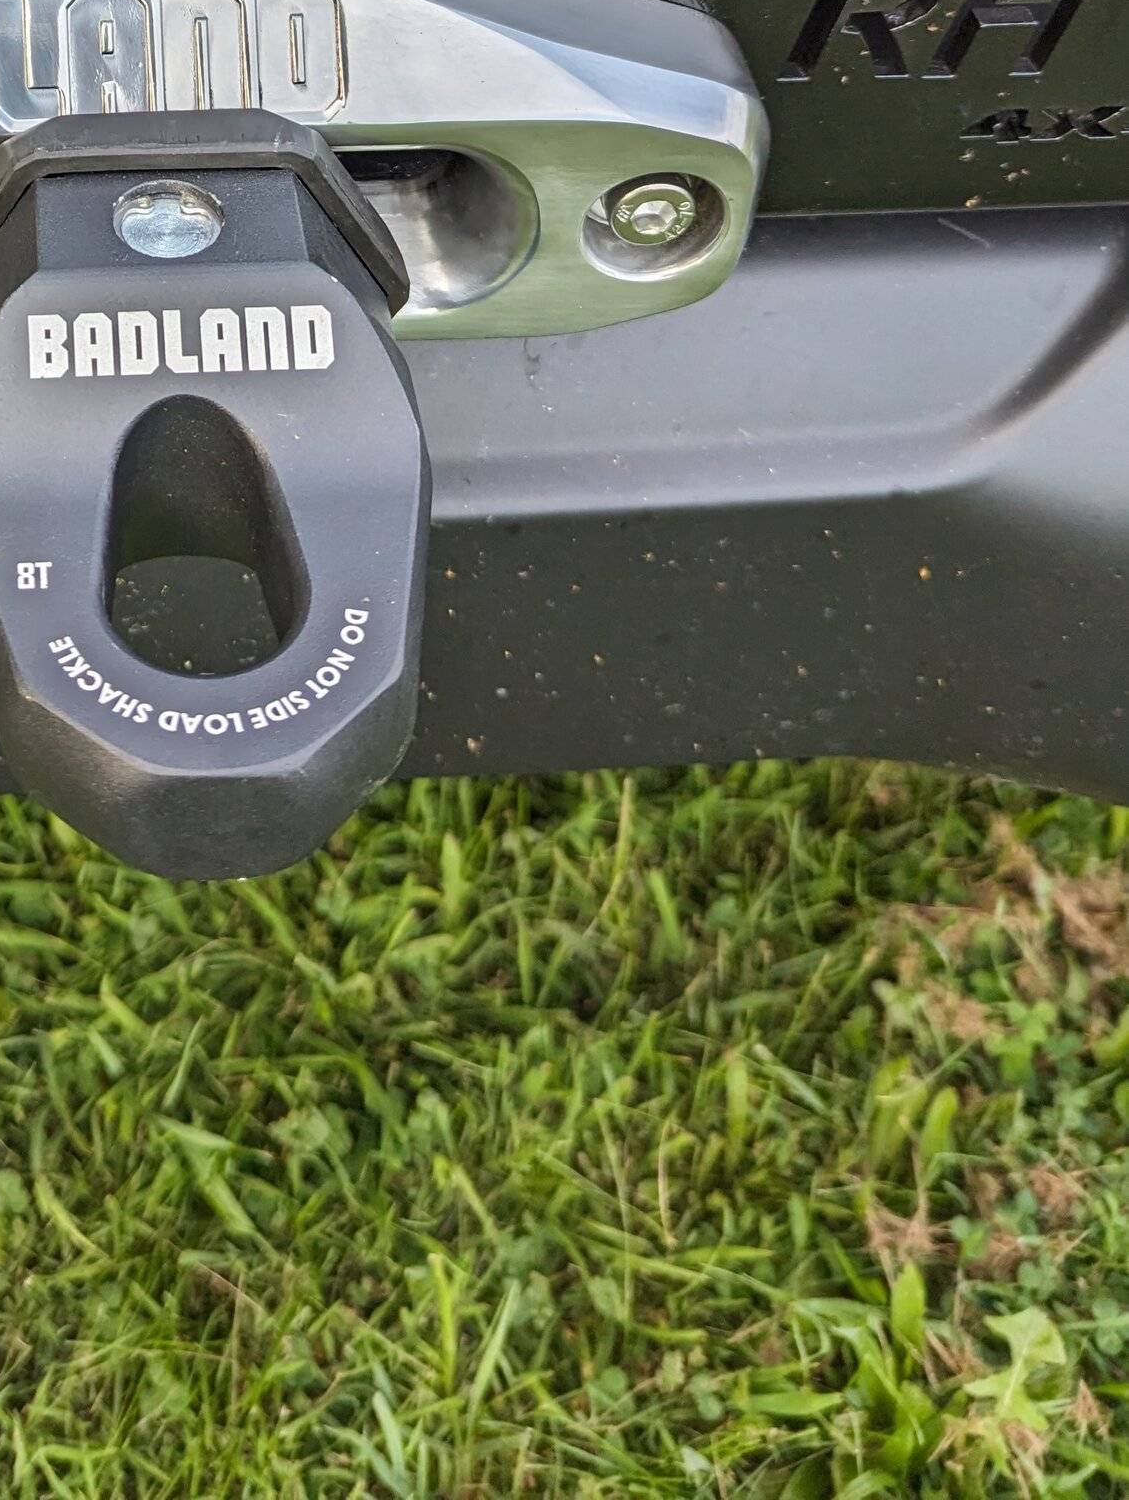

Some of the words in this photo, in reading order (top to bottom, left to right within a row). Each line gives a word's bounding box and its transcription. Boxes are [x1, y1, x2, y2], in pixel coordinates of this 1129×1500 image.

[27, 304, 335, 379] BADLAND
[16, 561, 53, 590] 8T
[339, 607, 370, 646] DO
[47, 634, 154, 725] SHACKLE
[304, 647, 357, 700] NOT
[157, 709, 246, 736] LOAD
[246, 689, 312, 731] SIDE
